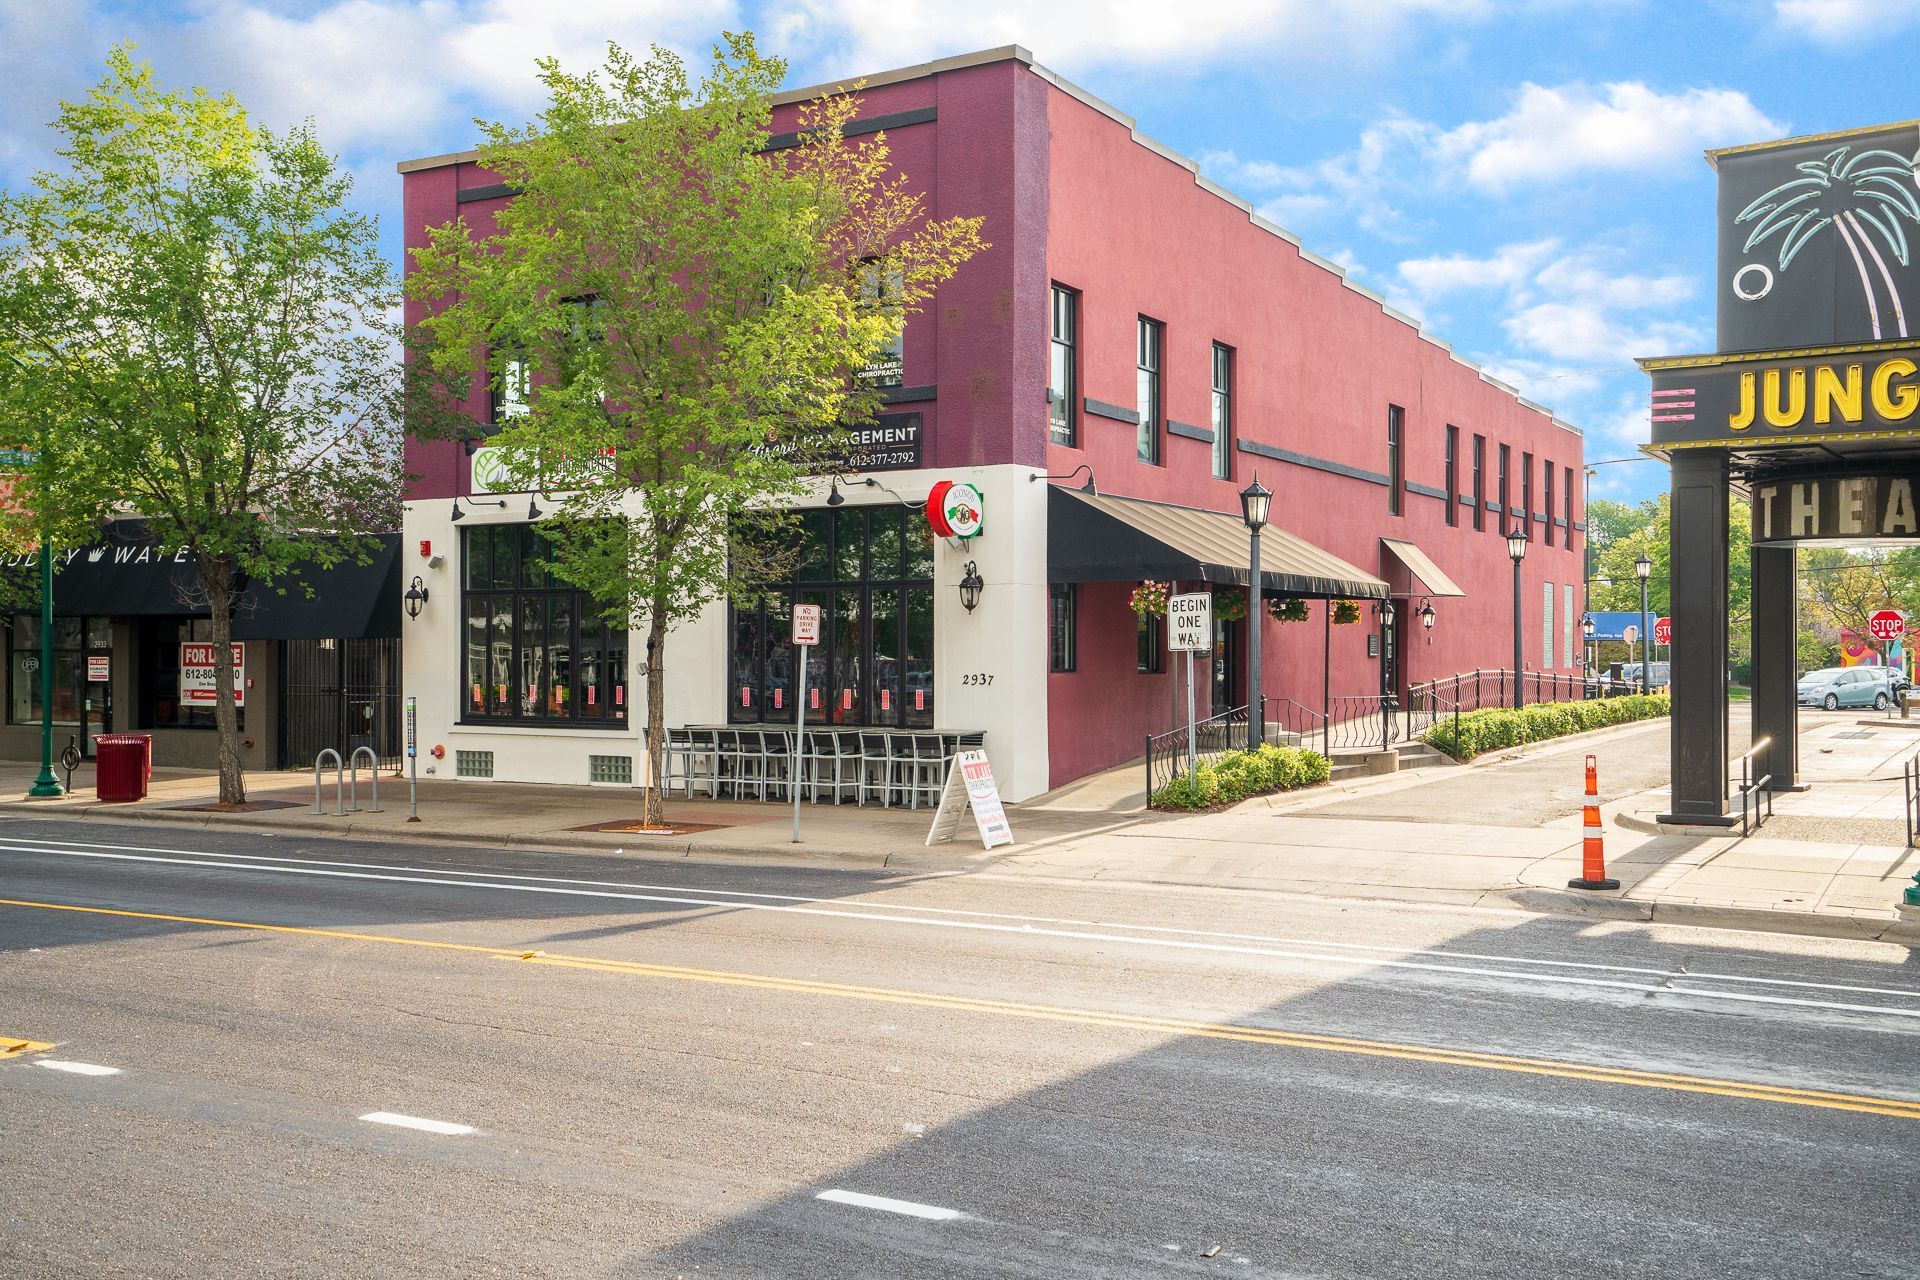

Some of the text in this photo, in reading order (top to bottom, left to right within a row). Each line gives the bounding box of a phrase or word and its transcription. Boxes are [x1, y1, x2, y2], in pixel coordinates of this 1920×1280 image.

[880, 361, 897, 370] LAKE
[849, 451, 915, 467] 612-377-2792
[1172, 598, 1207, 612] BEGIN
[1178, 615, 1201, 628] ONE
[1872, 619, 1902, 631] STOP
[94, 640, 107, 649] 2933
[186, 648, 206, 664] FOR
[962, 673, 995, 686] 2937
